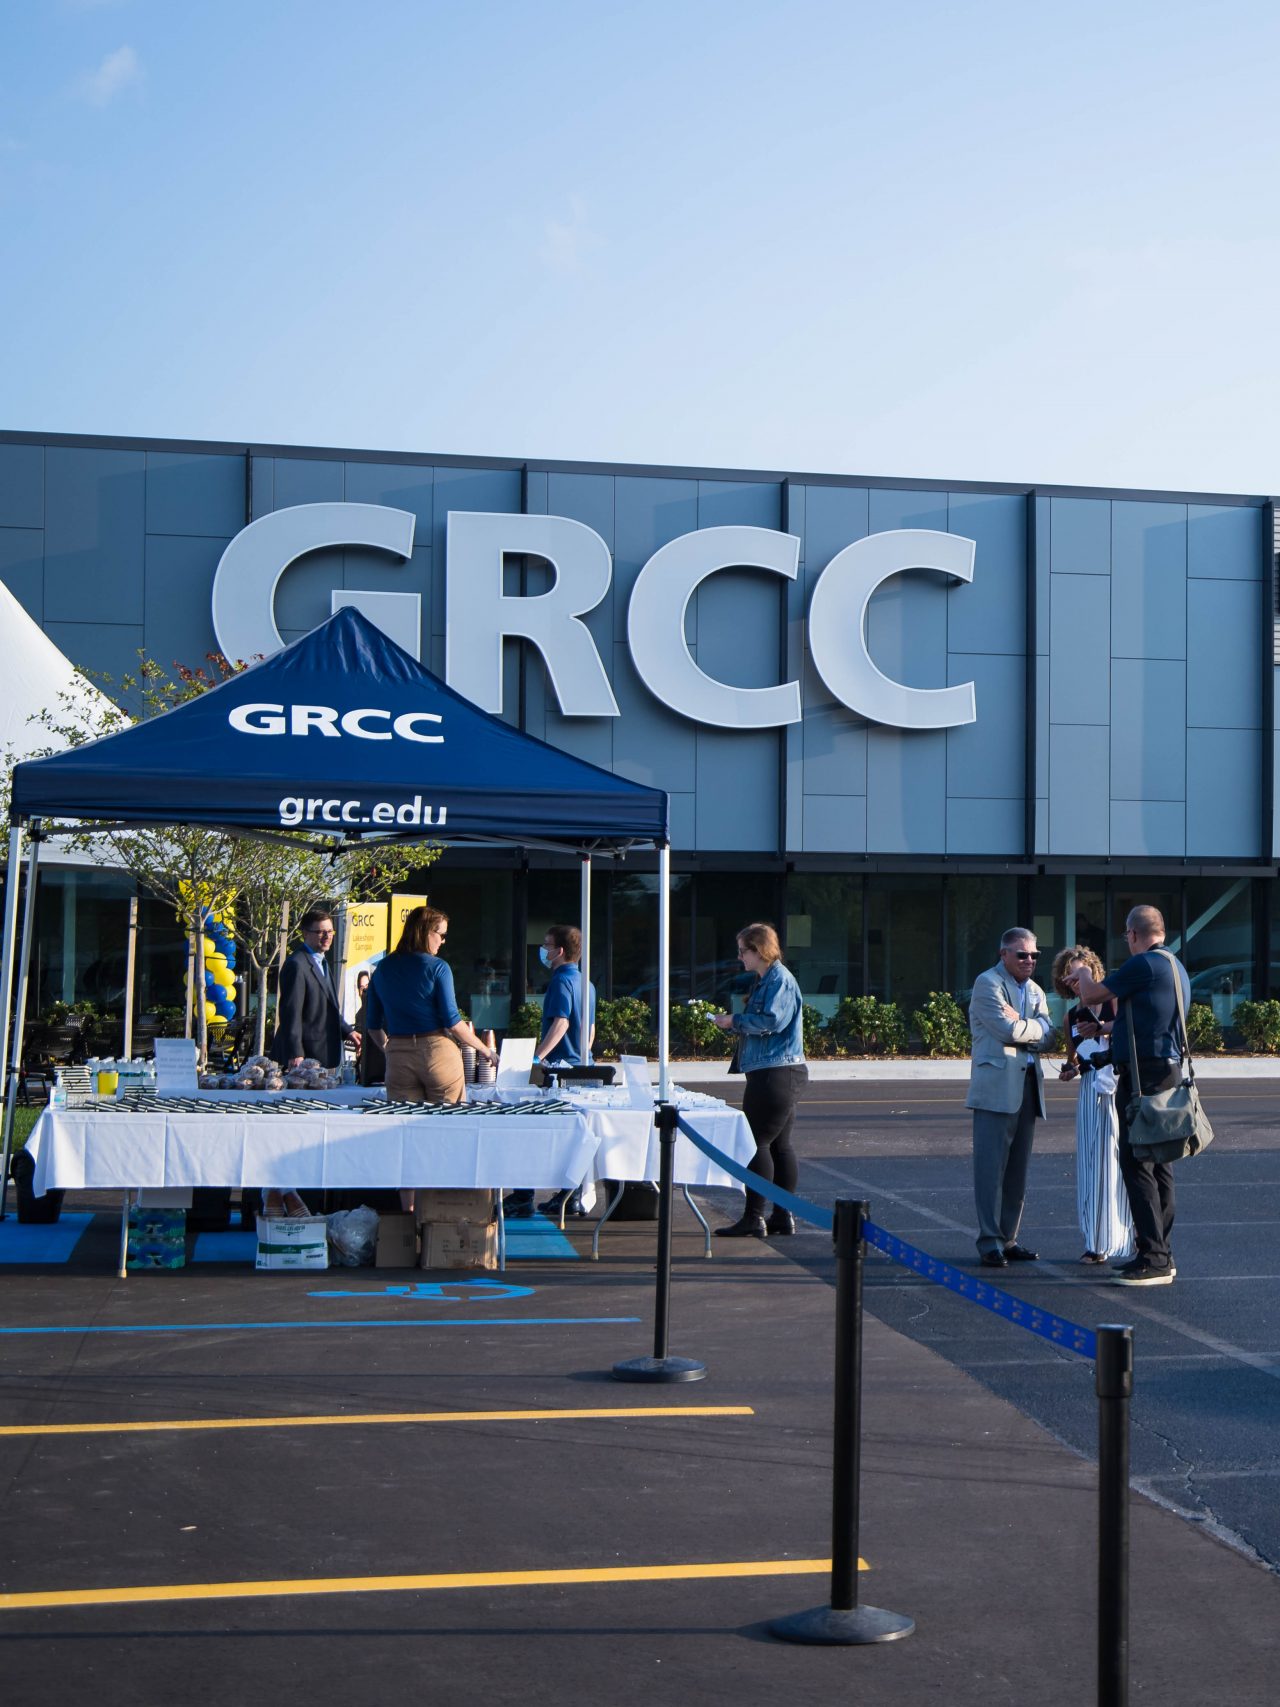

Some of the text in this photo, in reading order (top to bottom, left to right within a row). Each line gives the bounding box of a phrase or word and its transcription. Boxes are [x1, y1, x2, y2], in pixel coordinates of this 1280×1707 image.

[211, 502, 978, 730] GRCC
[228, 703, 445, 743] GRCC
[278, 795, 448, 826] grcc.edu
[351, 914, 375, 927] GRCC
